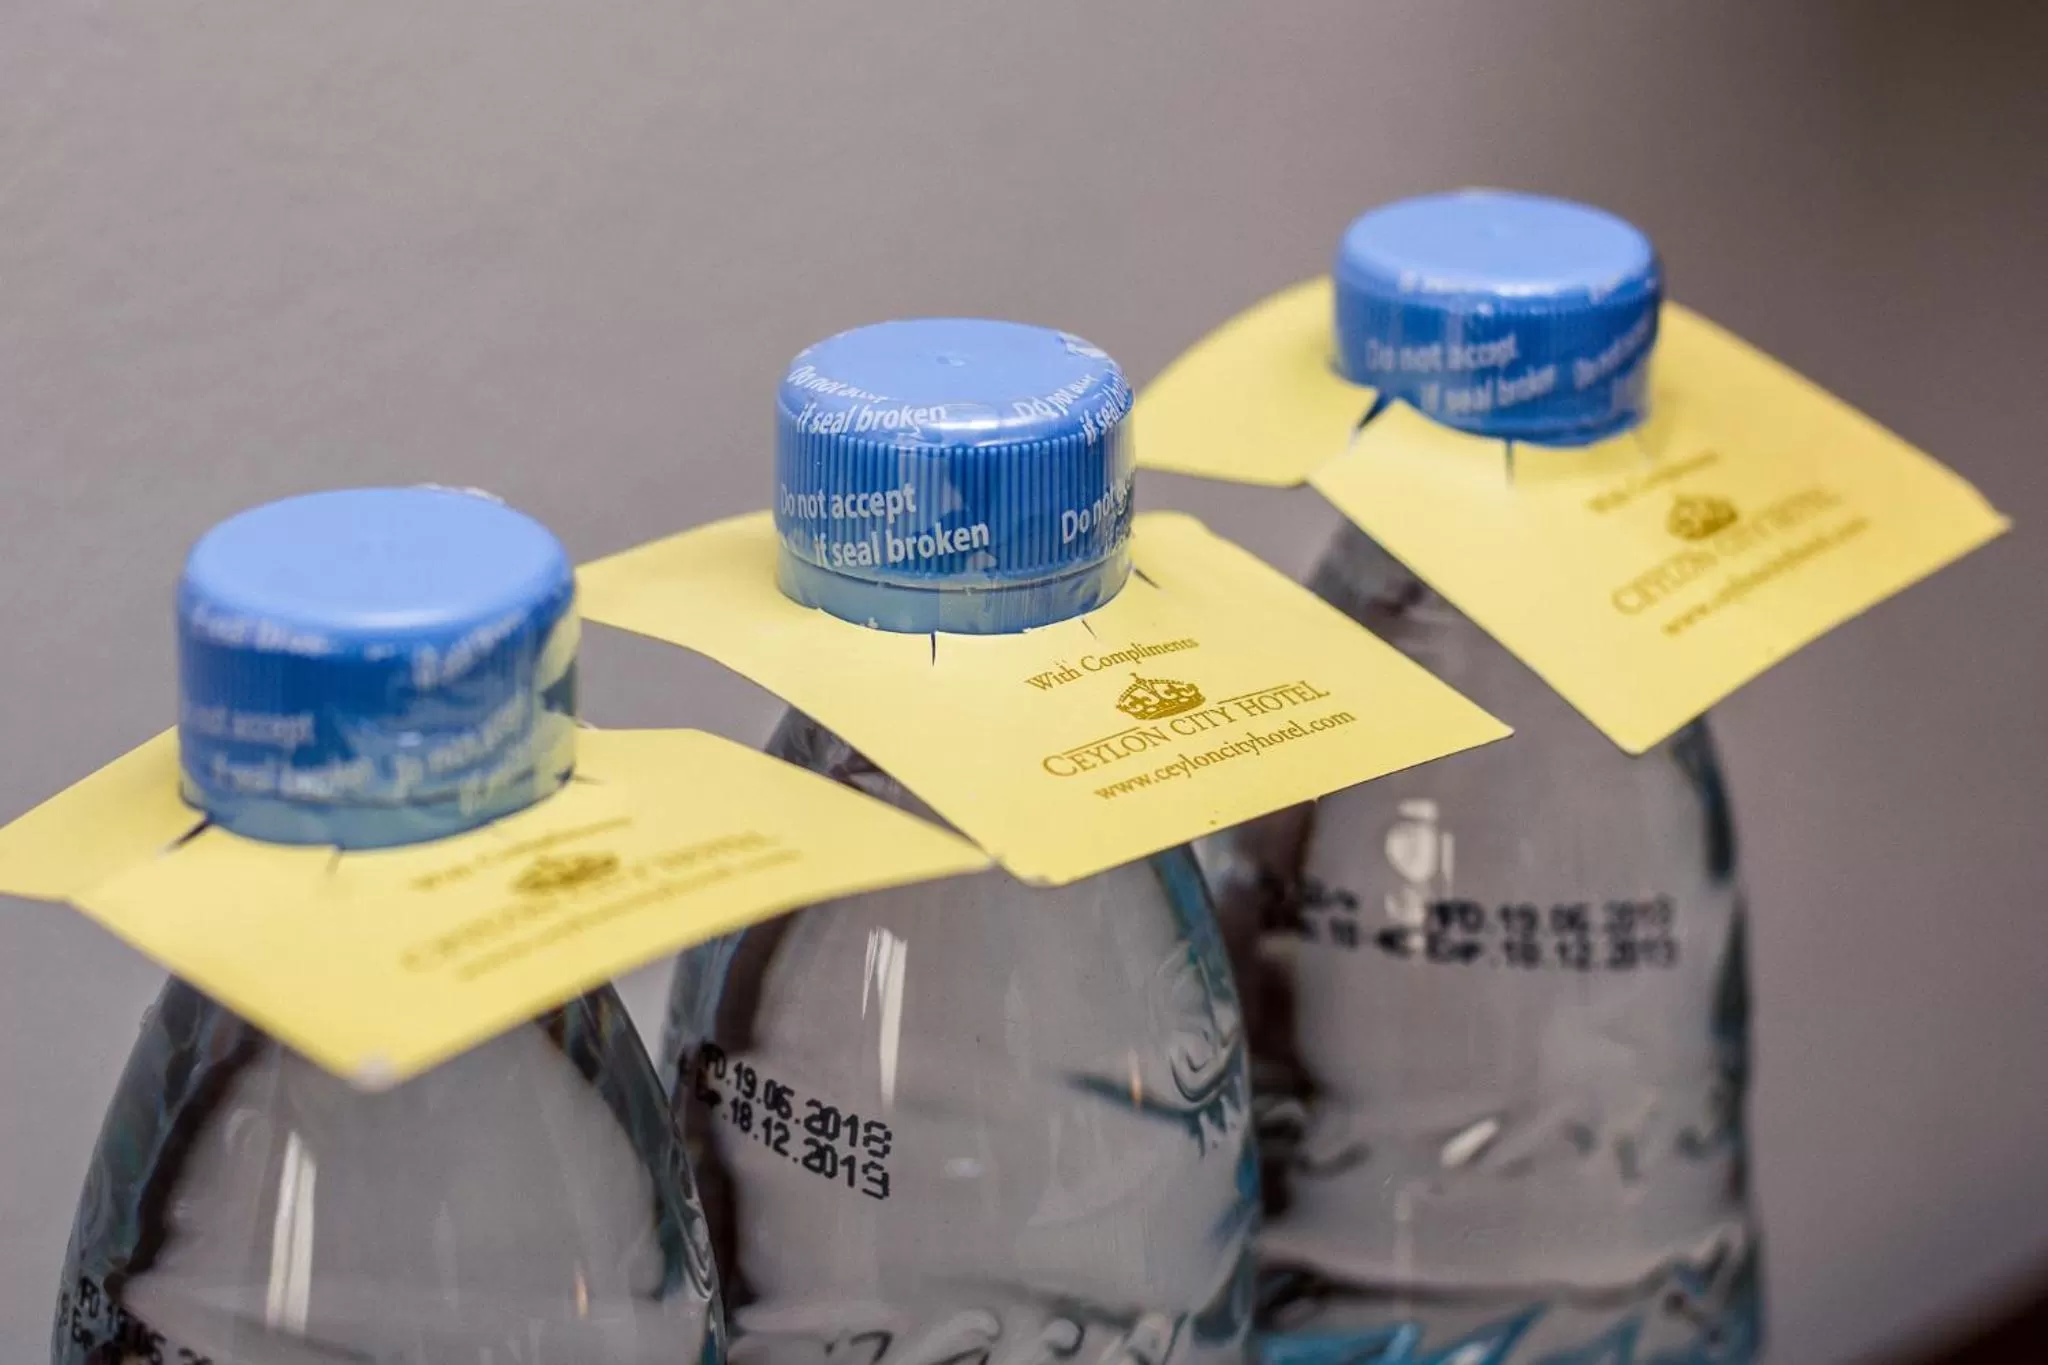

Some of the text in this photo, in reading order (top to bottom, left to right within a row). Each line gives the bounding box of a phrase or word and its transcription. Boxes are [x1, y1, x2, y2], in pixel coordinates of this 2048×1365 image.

[797, 403, 948, 435] if seal broken
[781, 482, 917, 524] Do not accept
[813, 521, 990, 568] if seal broken
[1061, 509, 1090, 545] Do
[1024, 637, 1200, 691] With Compliments
[1042, 680, 1331, 778] CEYLON CITY HOTEL
[1093, 710, 1358, 801] www.ceyloncityhotel.com
